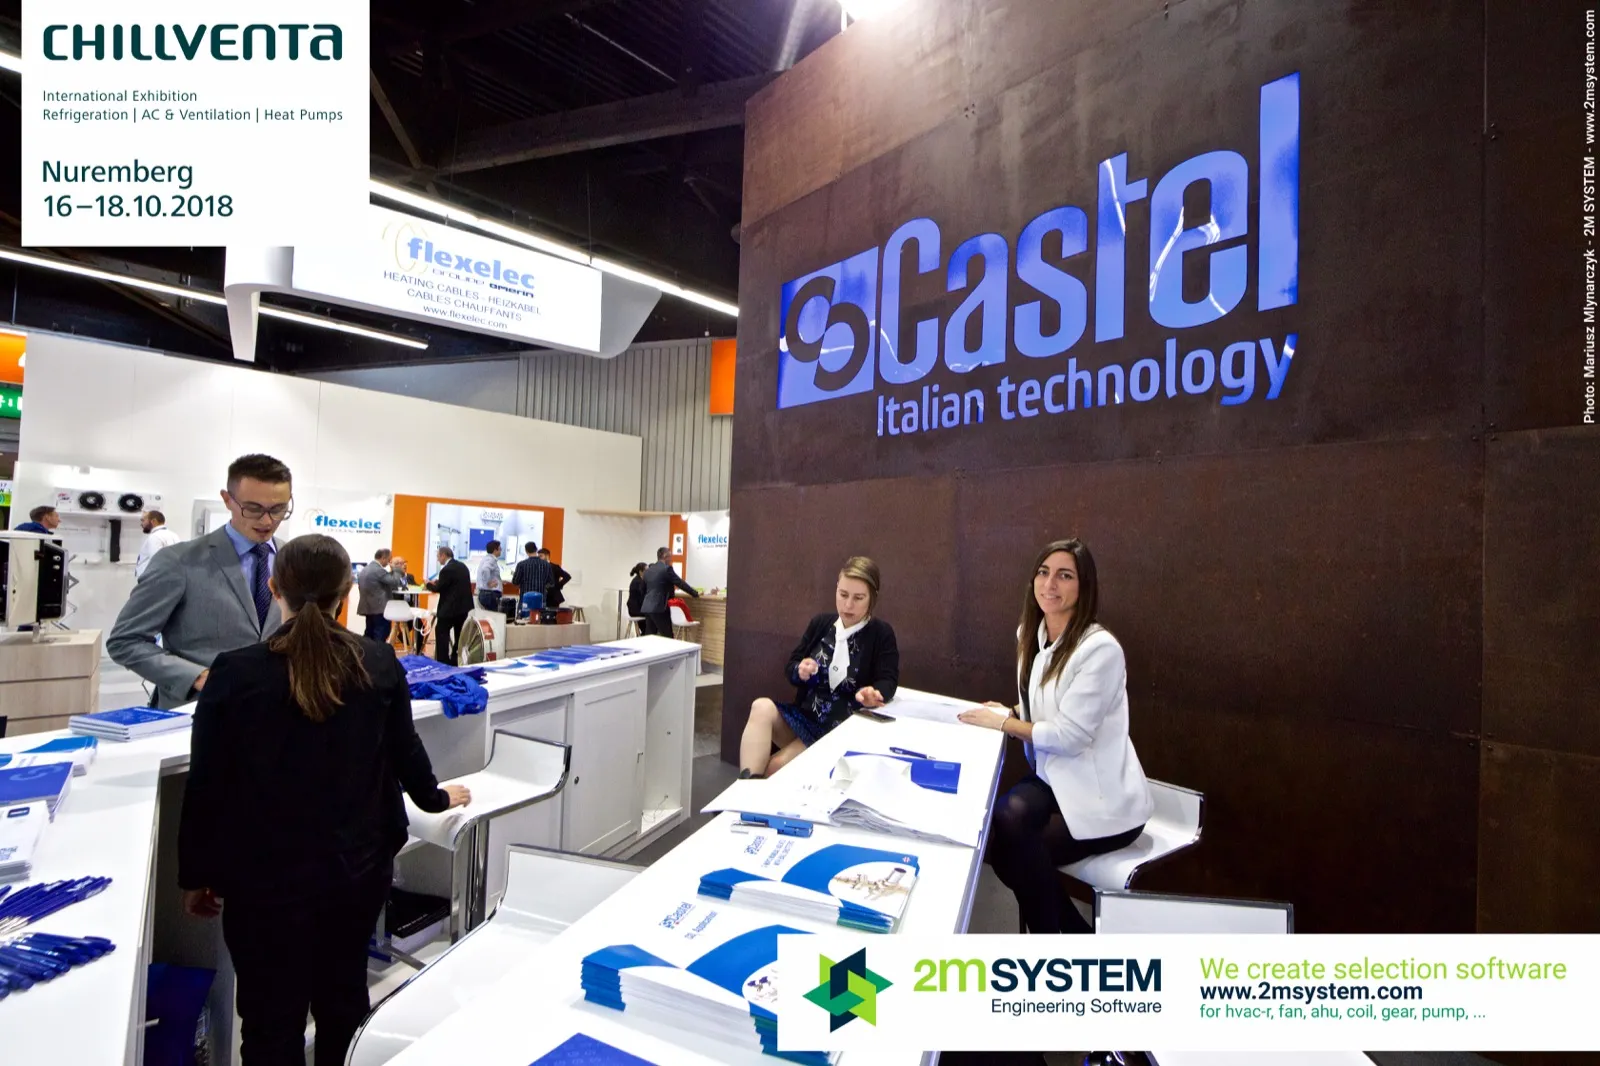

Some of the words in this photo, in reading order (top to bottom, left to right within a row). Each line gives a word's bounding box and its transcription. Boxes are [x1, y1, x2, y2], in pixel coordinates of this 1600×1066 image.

[879, 72, 1301, 384] Castel
[407, 237, 535, 290] flexelec
[383, 270, 434, 290] HEATING
[437, 283, 480, 301] CABLES
[488, 295, 541, 316] HEIZKABEL
[407, 288, 452, 306] CABLES
[453, 298, 523, 322] CHAUFFANTS
[423, 304, 508, 330] www.flexelec.com
[876, 383, 985, 437] Italian
[997, 333, 1299, 420] technology
[315, 514, 382, 530] flexelec
[697, 533, 728, 545] flexelec
